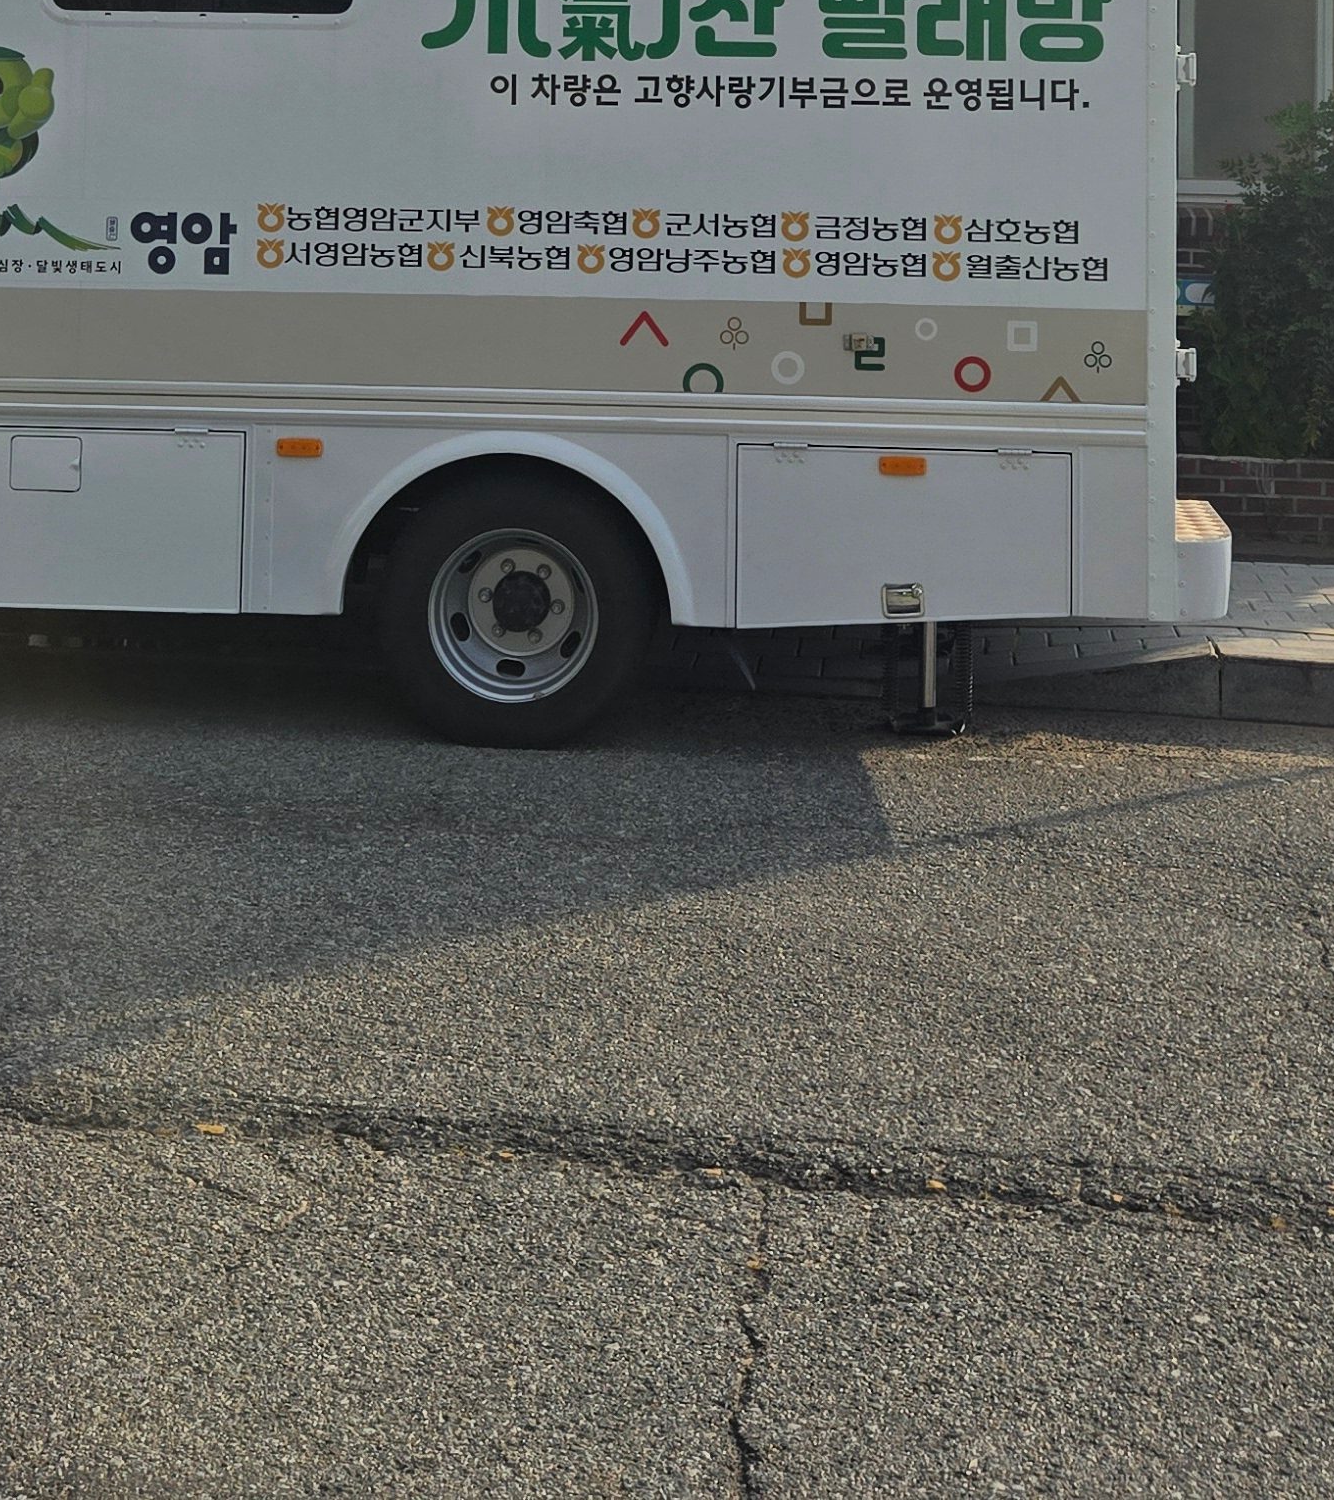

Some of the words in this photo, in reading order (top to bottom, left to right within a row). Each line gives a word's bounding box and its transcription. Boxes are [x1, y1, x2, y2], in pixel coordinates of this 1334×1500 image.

[490, 73, 517, 106] 이
[530, 73, 622, 108] 차량은
[634, 74, 912, 110] 고향사랑기부금으로
[923, 77, 1091, 112] 운영됩니다.
[130, 211, 238, 276] 영암
[286, 206, 480, 233] 농협영암군지부
[517, 210, 628, 236] 영암축협
[665, 213, 777, 239] 군서농협
[814, 216, 927, 242] 금정농협
[964, 218, 1079, 245] 삼호농협
[284, 241, 423, 268] 서영암농협
[459, 244, 570, 271] 신북농협
[608, 246, 776, 275] 영암낭주농협
[814, 251, 927, 278] 영암농협
[965, 254, 1108, 282] 월출산농협
